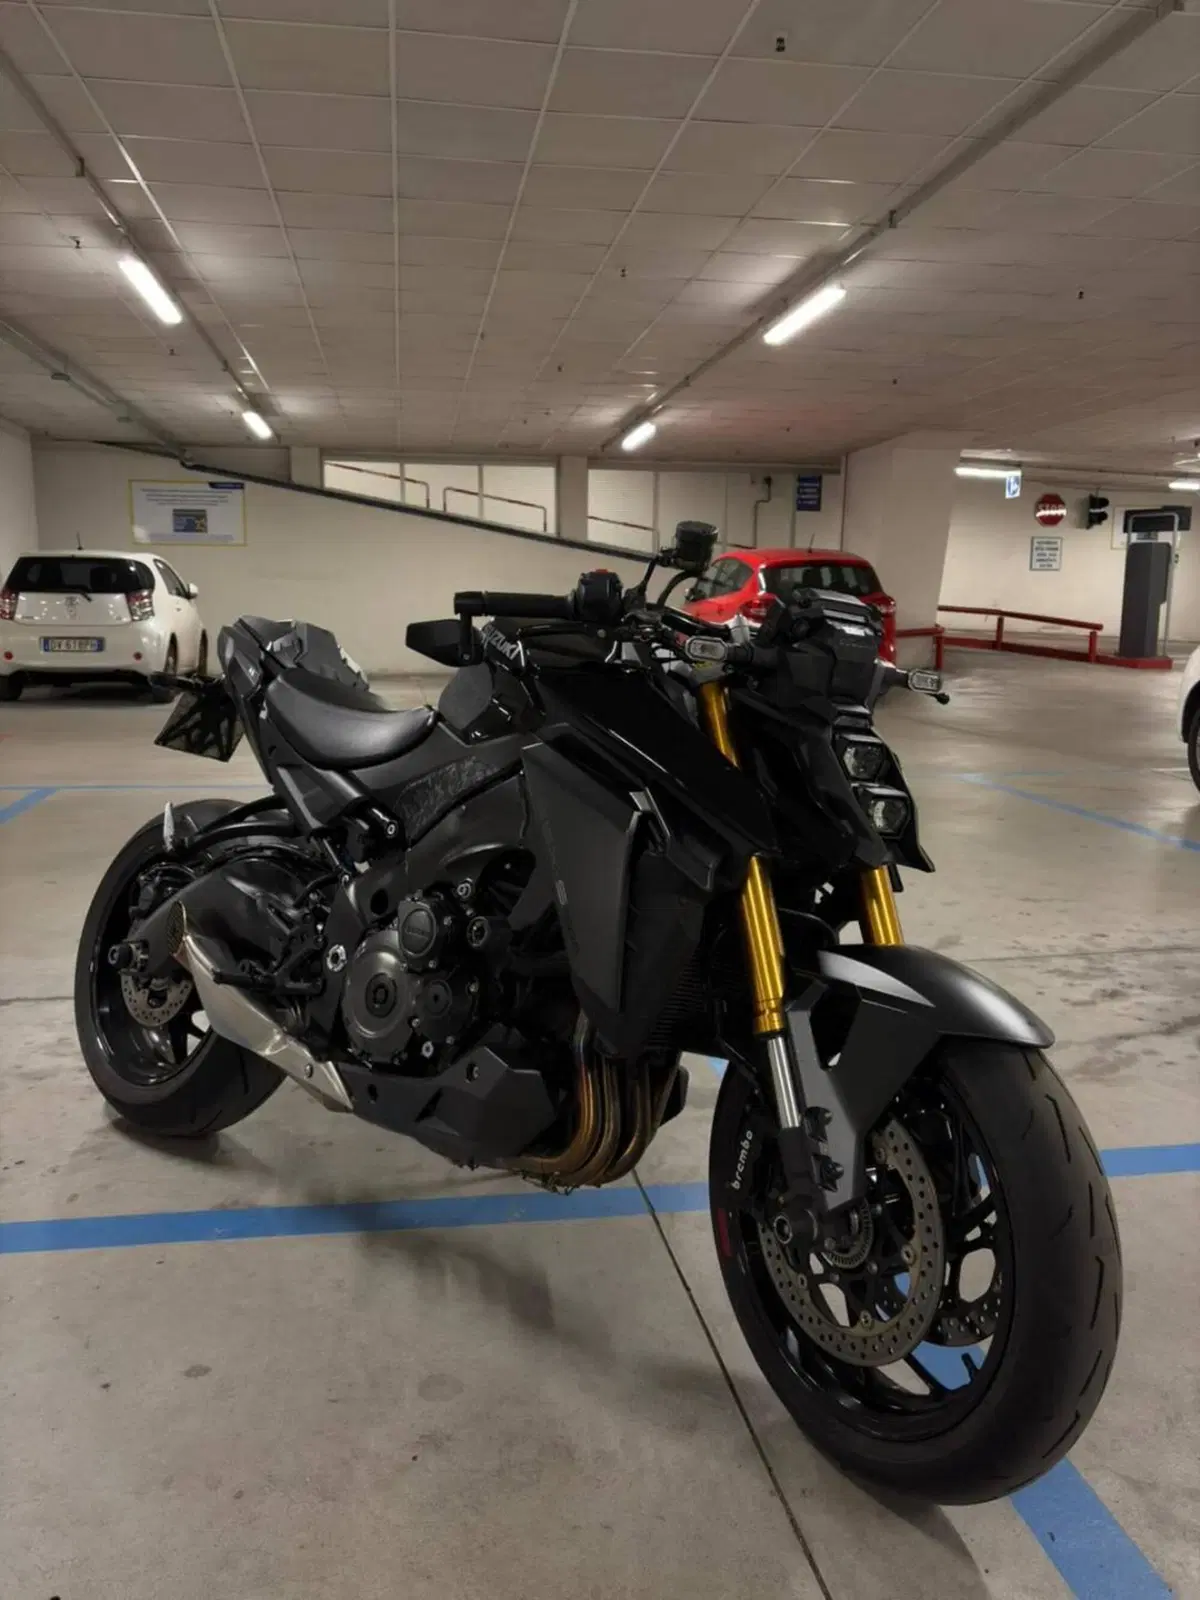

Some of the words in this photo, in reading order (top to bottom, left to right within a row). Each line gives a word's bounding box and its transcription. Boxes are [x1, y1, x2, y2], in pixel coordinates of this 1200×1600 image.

[1036, 503, 1067, 516] STOP
[482, 623, 521, 660] SUZUKI
[731, 1130, 753, 1190] brembo
